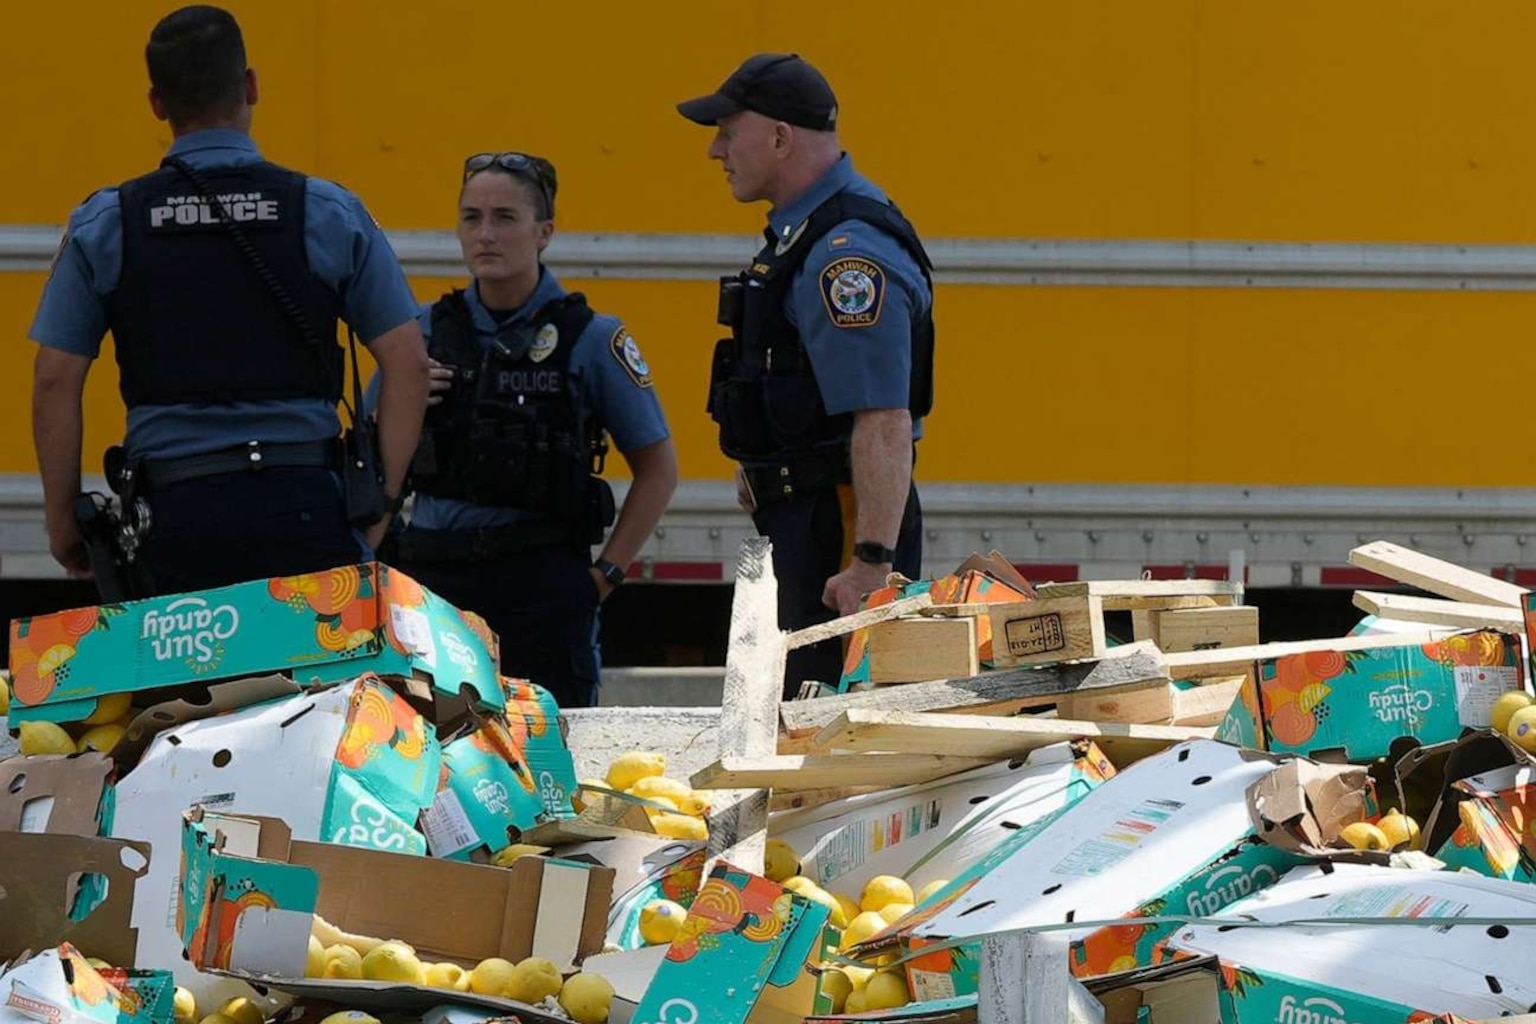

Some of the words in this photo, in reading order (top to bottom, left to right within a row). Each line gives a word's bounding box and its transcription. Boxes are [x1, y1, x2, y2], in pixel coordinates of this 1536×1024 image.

[150, 200, 279, 227] POLICE
[826, 261, 878, 280] MAHWAH
[837, 313, 873, 323] POLICE
[499, 371, 560, 393] POLICE
[140, 603, 239, 640] Candy
[152, 630, 213, 663] Sun
[1368, 690, 1433, 712] Candy
[1376, 706, 1419, 725] Sun
